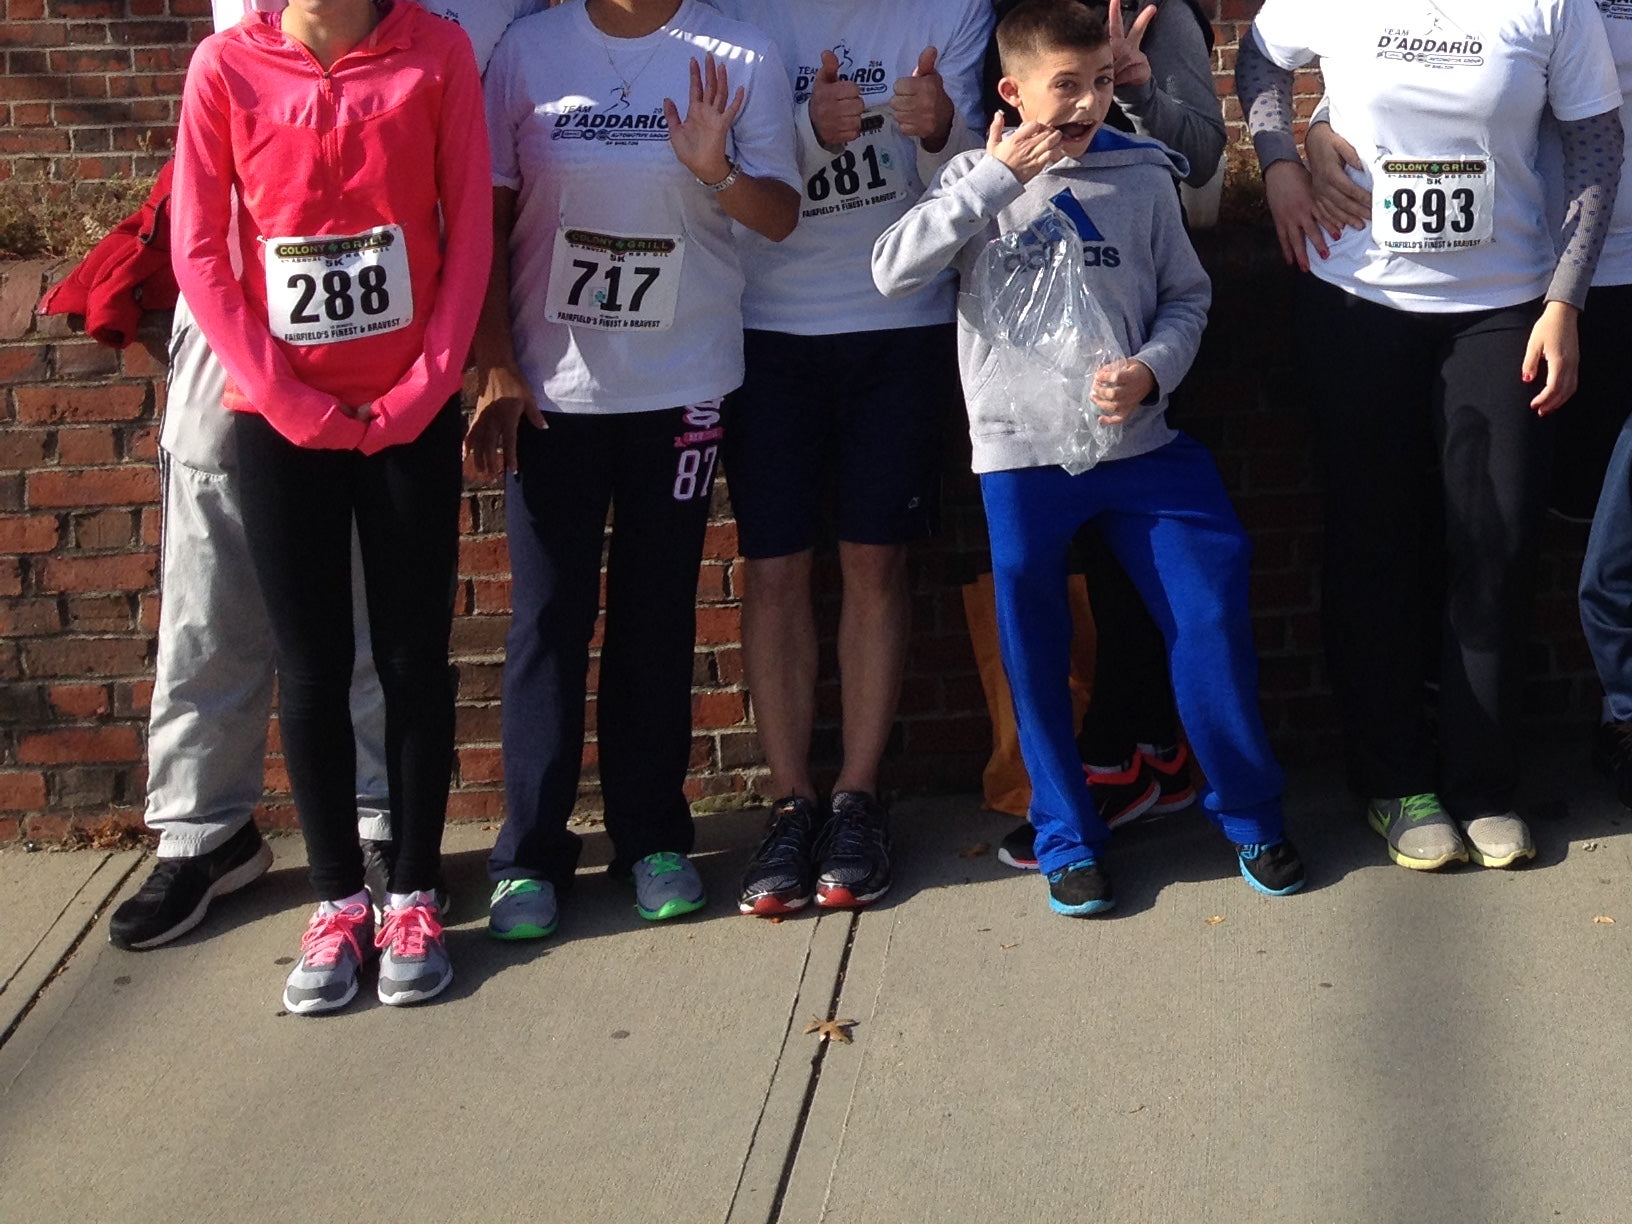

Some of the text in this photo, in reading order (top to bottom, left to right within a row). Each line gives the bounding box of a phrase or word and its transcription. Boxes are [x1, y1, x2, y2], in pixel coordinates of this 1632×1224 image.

[1377, 36, 1483, 55] D'ADDARIO
[562, 105, 593, 114] TEAM
[1388, 163, 1481, 171] COLONY GRILL
[1392, 188, 1475, 234] 893
[279, 234, 388, 256] COLONY GRILL
[627, 239, 669, 249] GRILL
[325, 258, 345, 267] 5K
[610, 254, 626, 263] 5K
[287, 264, 390, 325] 288
[567, 258, 661, 312] 717
[284, 330, 330, 342] FAIRFIELD'S
[330, 326, 358, 339] FINEST
[367, 317, 401, 333] BRAVEST
[673, 444, 718, 501] 87
